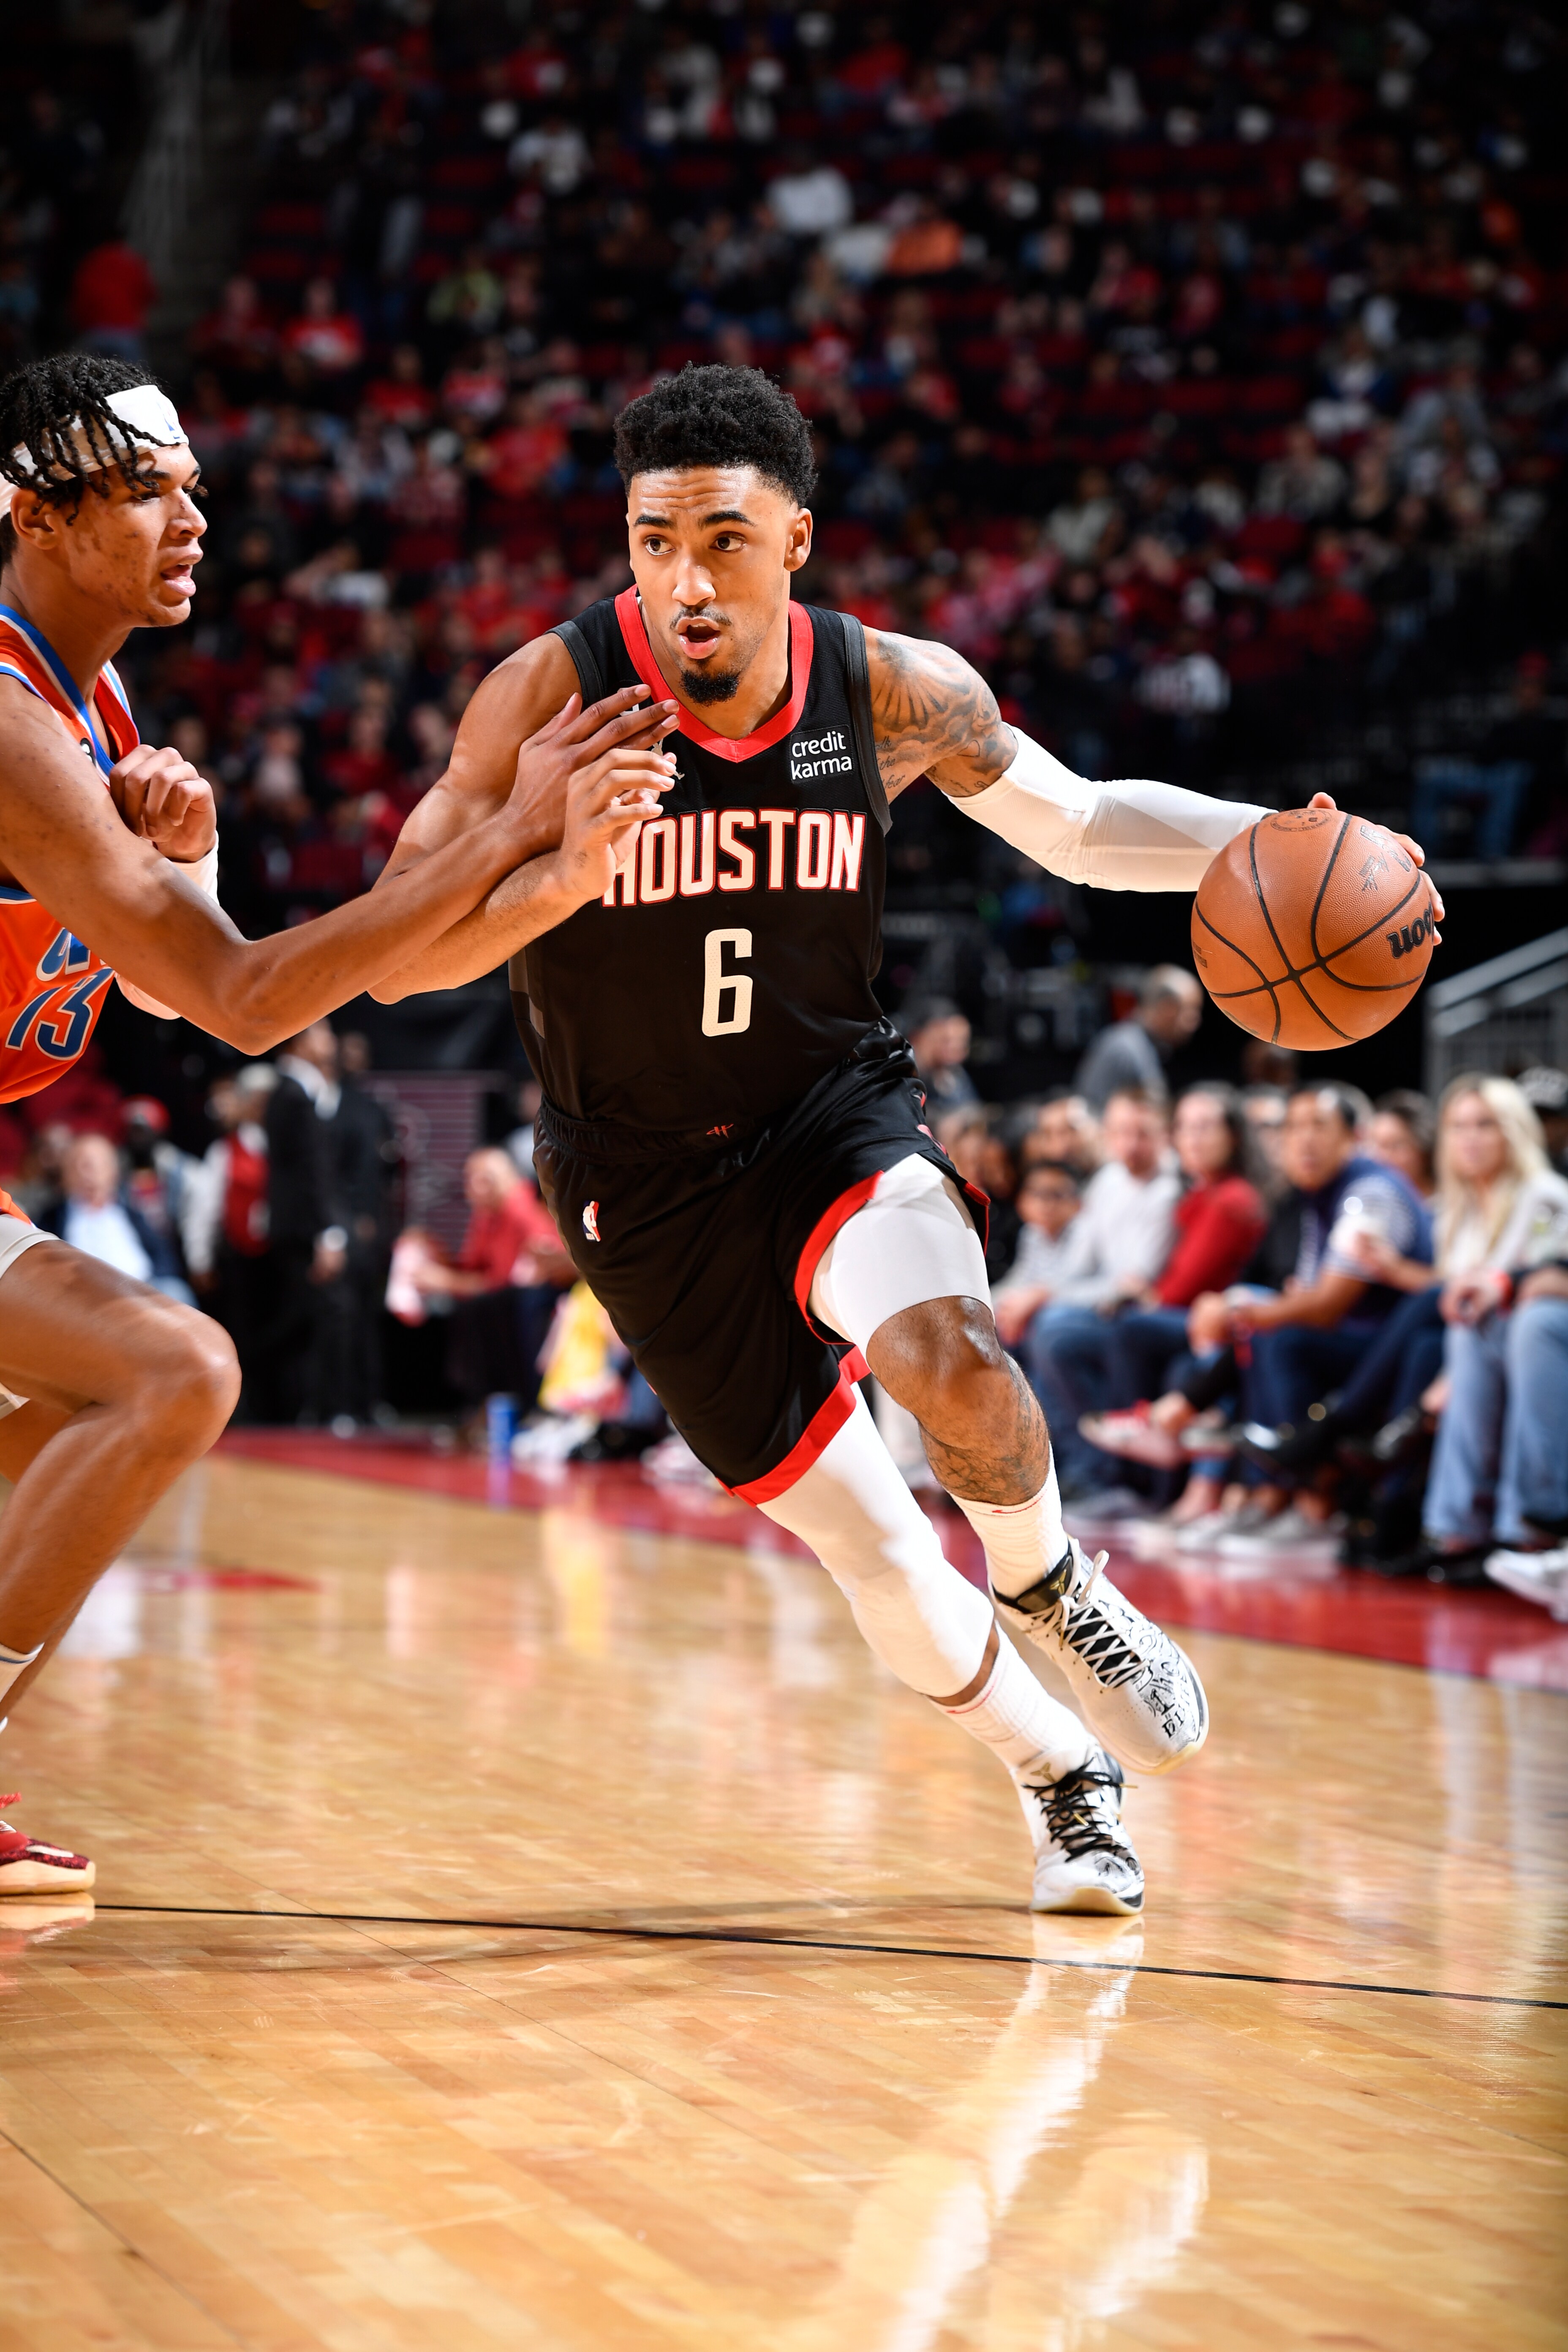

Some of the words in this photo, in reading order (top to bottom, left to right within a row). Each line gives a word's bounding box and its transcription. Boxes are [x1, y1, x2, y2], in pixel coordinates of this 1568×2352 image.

[790, 756, 852, 780] karma
[792, 731, 847, 757] credit
[701, 928, 753, 1037] 6
[5, 966, 115, 1061] 13
